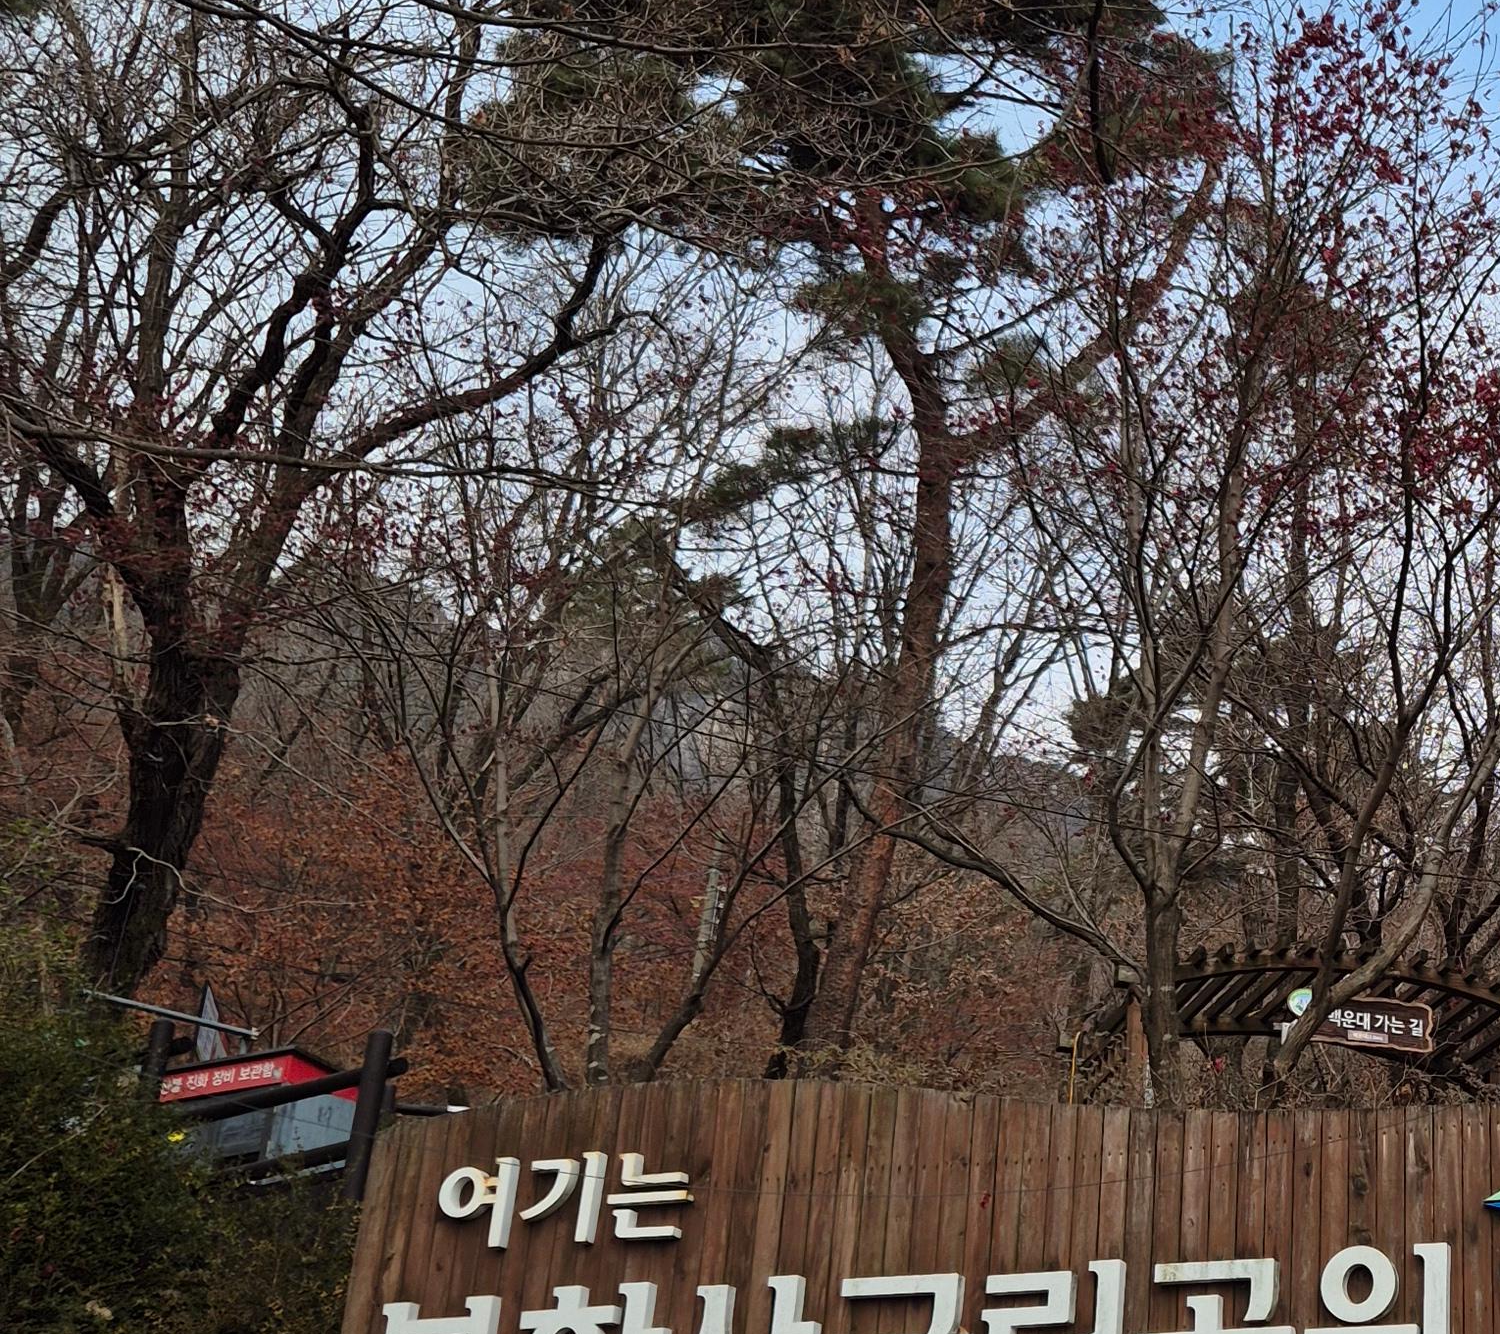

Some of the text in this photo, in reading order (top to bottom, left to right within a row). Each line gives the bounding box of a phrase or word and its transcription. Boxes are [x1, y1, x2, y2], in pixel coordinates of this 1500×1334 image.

[1328, 1009, 1423, 1037] 백운대 가는 길
[212, 1068, 235, 1086] 장비
[238, 1062, 275, 1080] 보관함
[438, 1151, 695, 1250] 여기는
